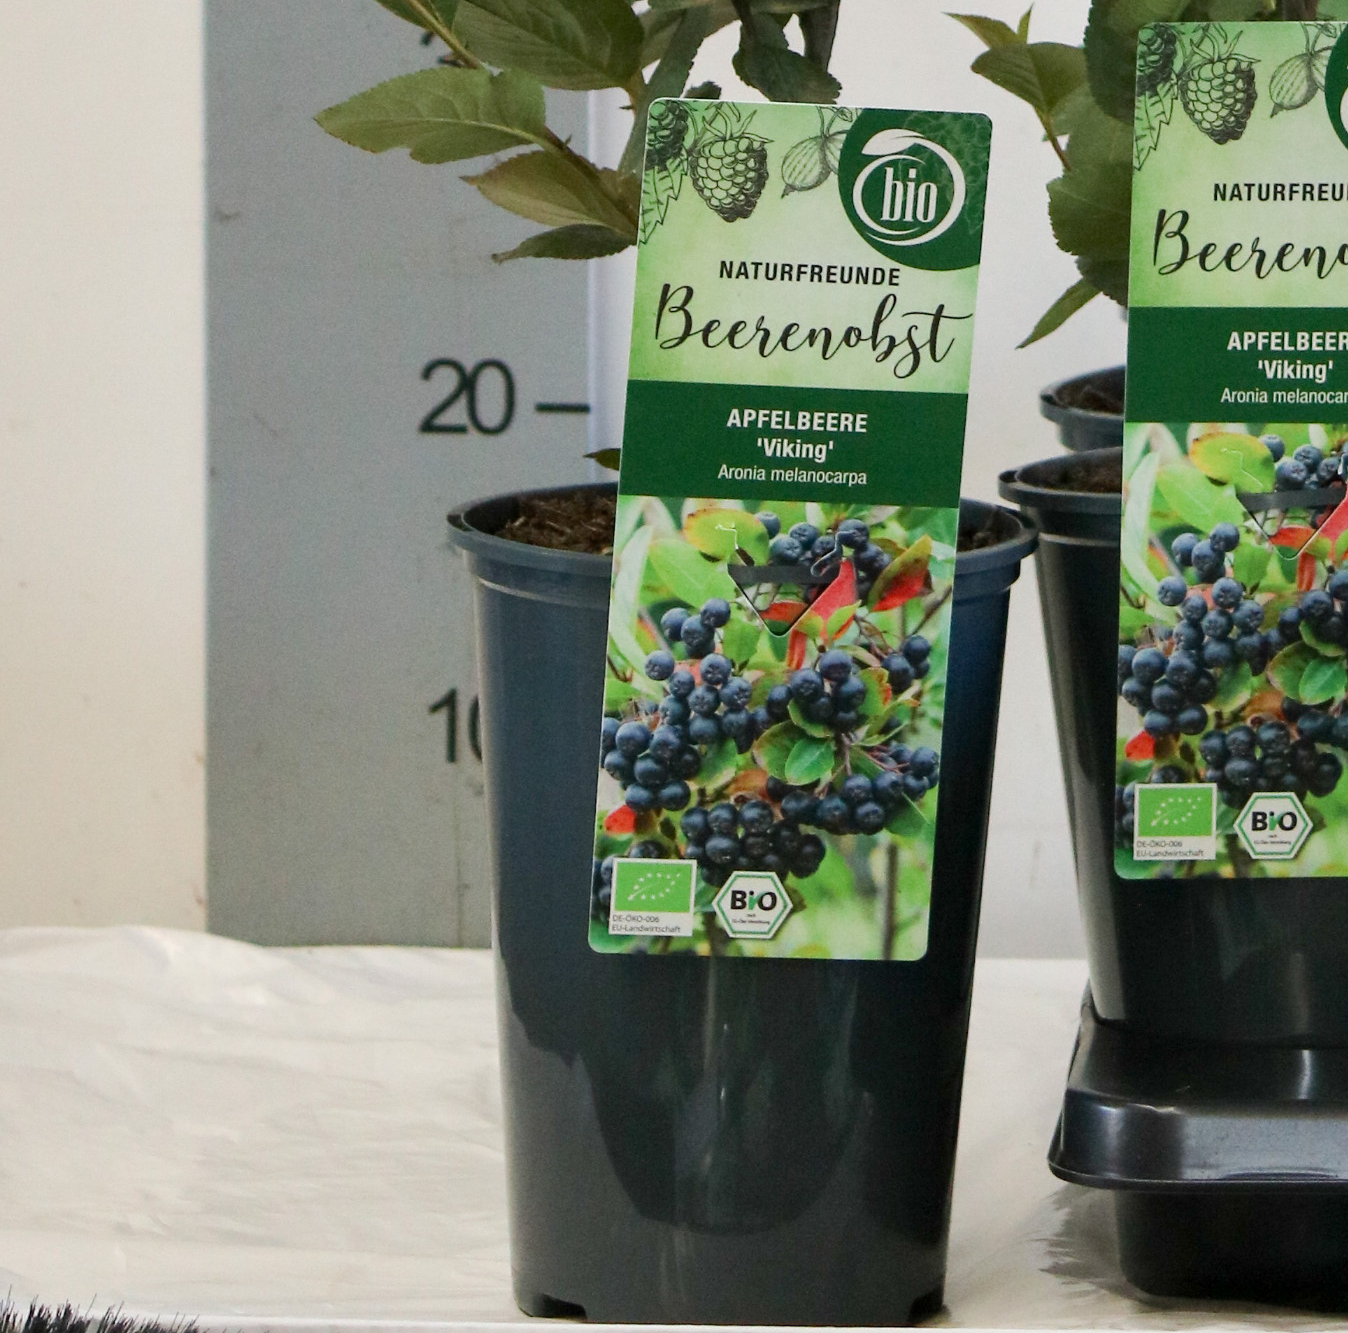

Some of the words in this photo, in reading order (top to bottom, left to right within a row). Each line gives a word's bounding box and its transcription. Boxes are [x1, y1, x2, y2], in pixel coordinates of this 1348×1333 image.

[880, 166, 939, 224] bio
[719, 260, 901, 286] NATURFREUNDE
[655, 283, 974, 380] Beerenobst
[1258, 359, 1334, 384] 'Viking'
[418, 358, 516, 436] 20
[1220, 388, 1269, 404] Aronia
[727, 408, 869, 433] APFELBEERE
[757, 438, 834, 464] 'Viking'
[718, 464, 767, 481] Aronia
[769, 466, 868, 486] melanocarpa
[1136, 849, 1204, 857] EU-Landwirtschaft
[611, 923, 682, 933] EU-Landwirtschaft
